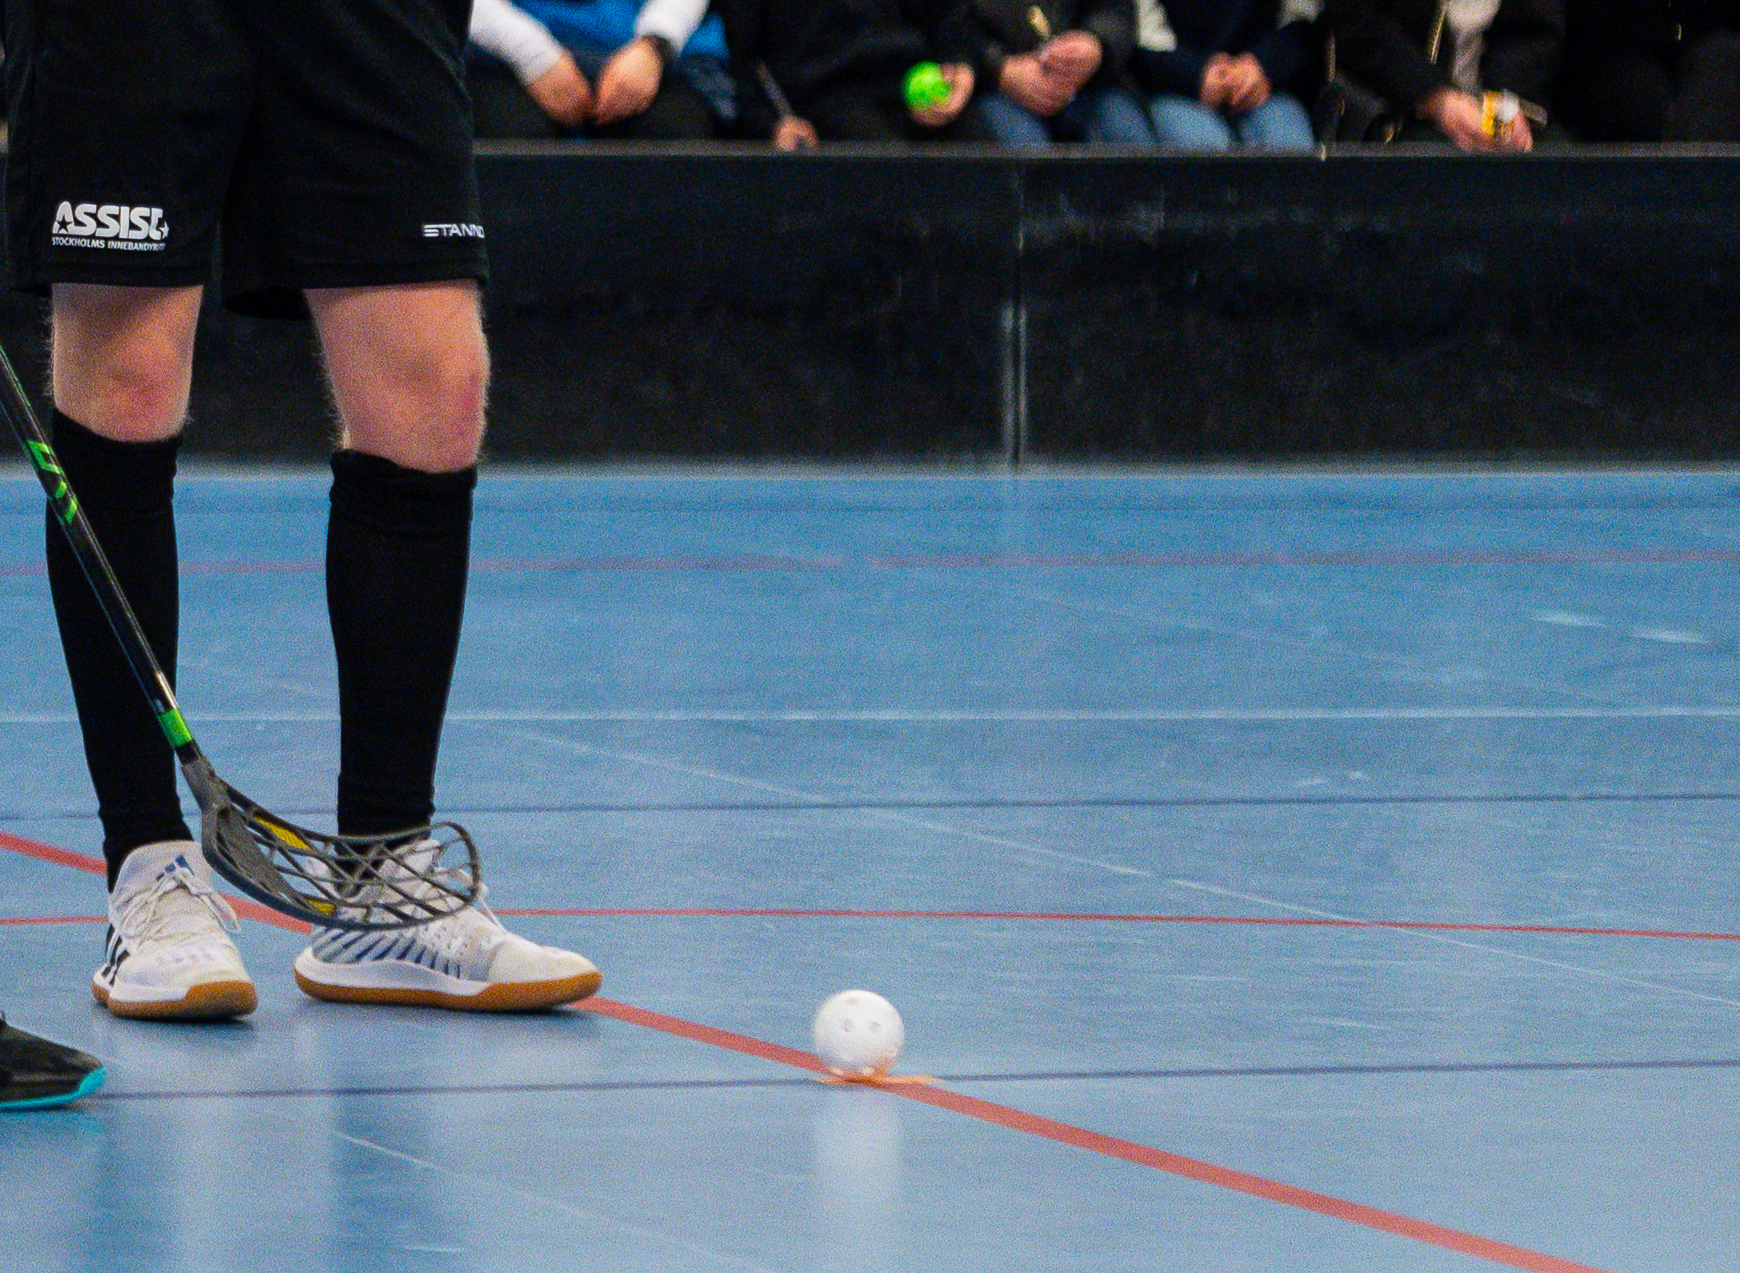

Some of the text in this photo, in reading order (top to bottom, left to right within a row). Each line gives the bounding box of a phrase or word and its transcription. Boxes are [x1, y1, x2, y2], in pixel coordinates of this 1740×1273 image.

[52, 200, 169, 241] ASSIST
[423, 223, 486, 239] STANNO
[52, 236, 106, 249] STOCKHOLMS
